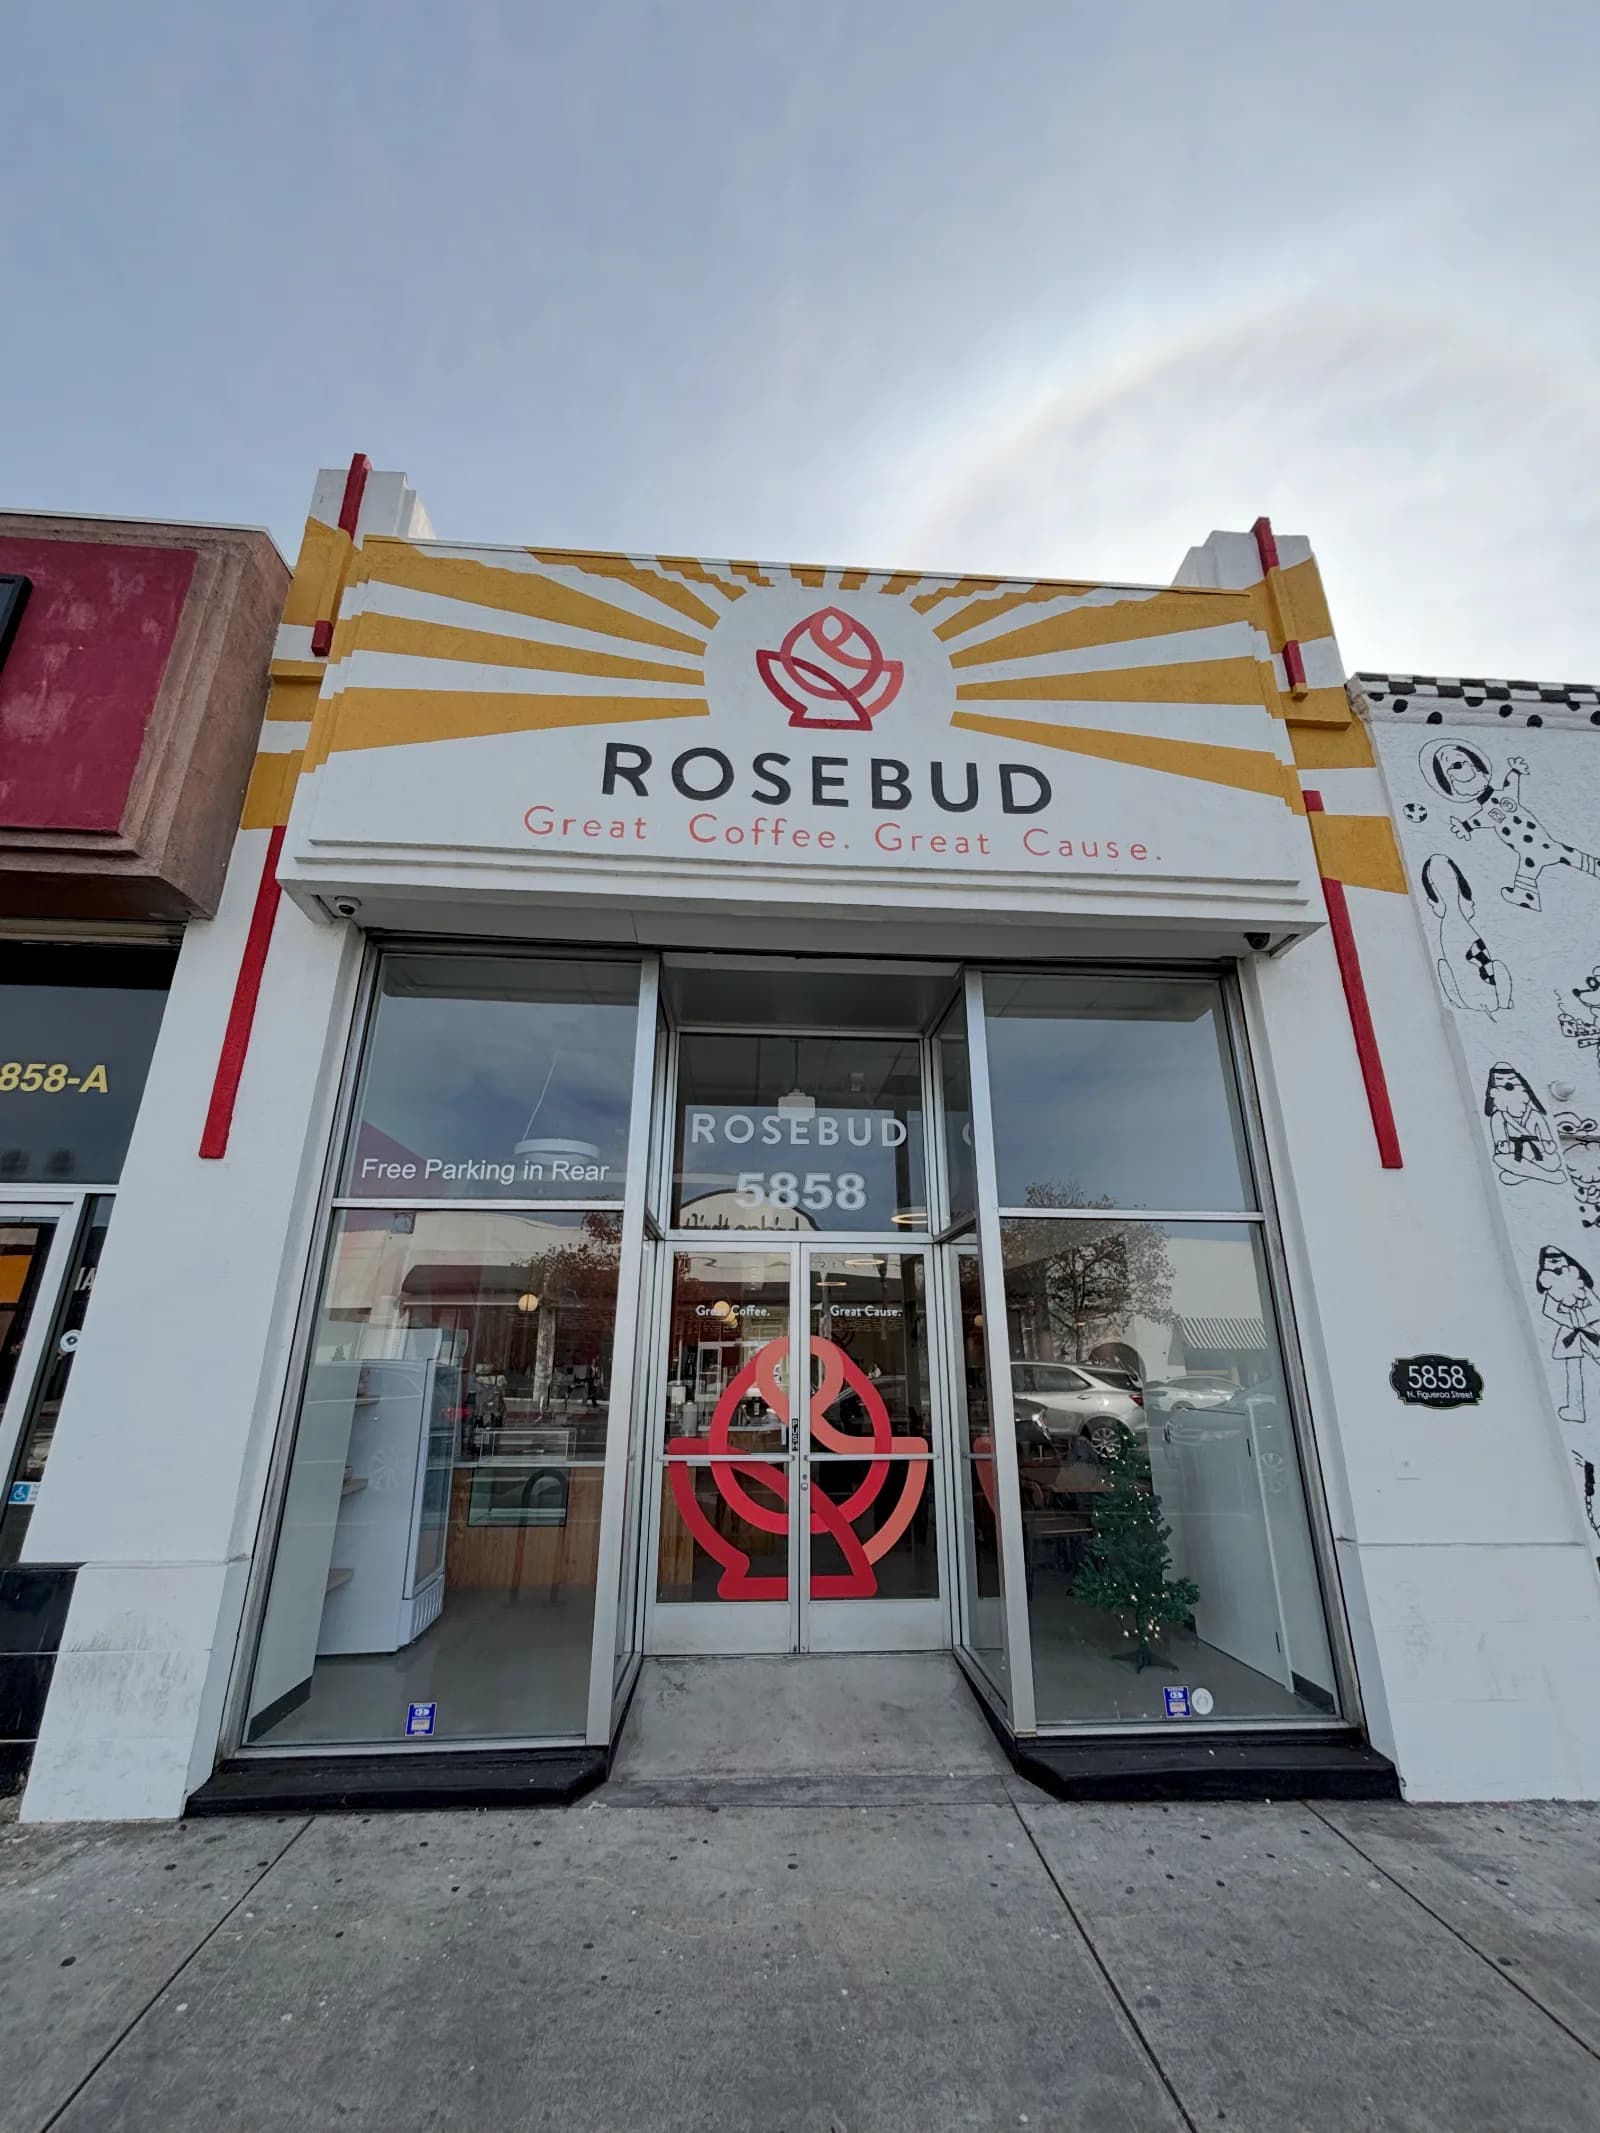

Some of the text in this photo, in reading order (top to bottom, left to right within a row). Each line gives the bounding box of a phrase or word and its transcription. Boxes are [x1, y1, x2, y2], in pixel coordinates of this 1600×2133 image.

[602, 742, 1052, 814] ROSEBUD
[524, 806, 1163, 861] Great Coffee. Great Cause.
[691, 1113, 908, 1147] ROSEBUD
[361, 1158, 610, 1185] Free Parking in Rear
[736, 1172, 866, 1211] 5858
[731, 1305, 770, 1316] Coffee.
[830, 1305, 902, 1317] Great Cause.
[1408, 1365, 1467, 1389] 5858
[1416, 1391, 1450, 1400] Figueroa
[1450, 1391, 1473, 1399] Street
